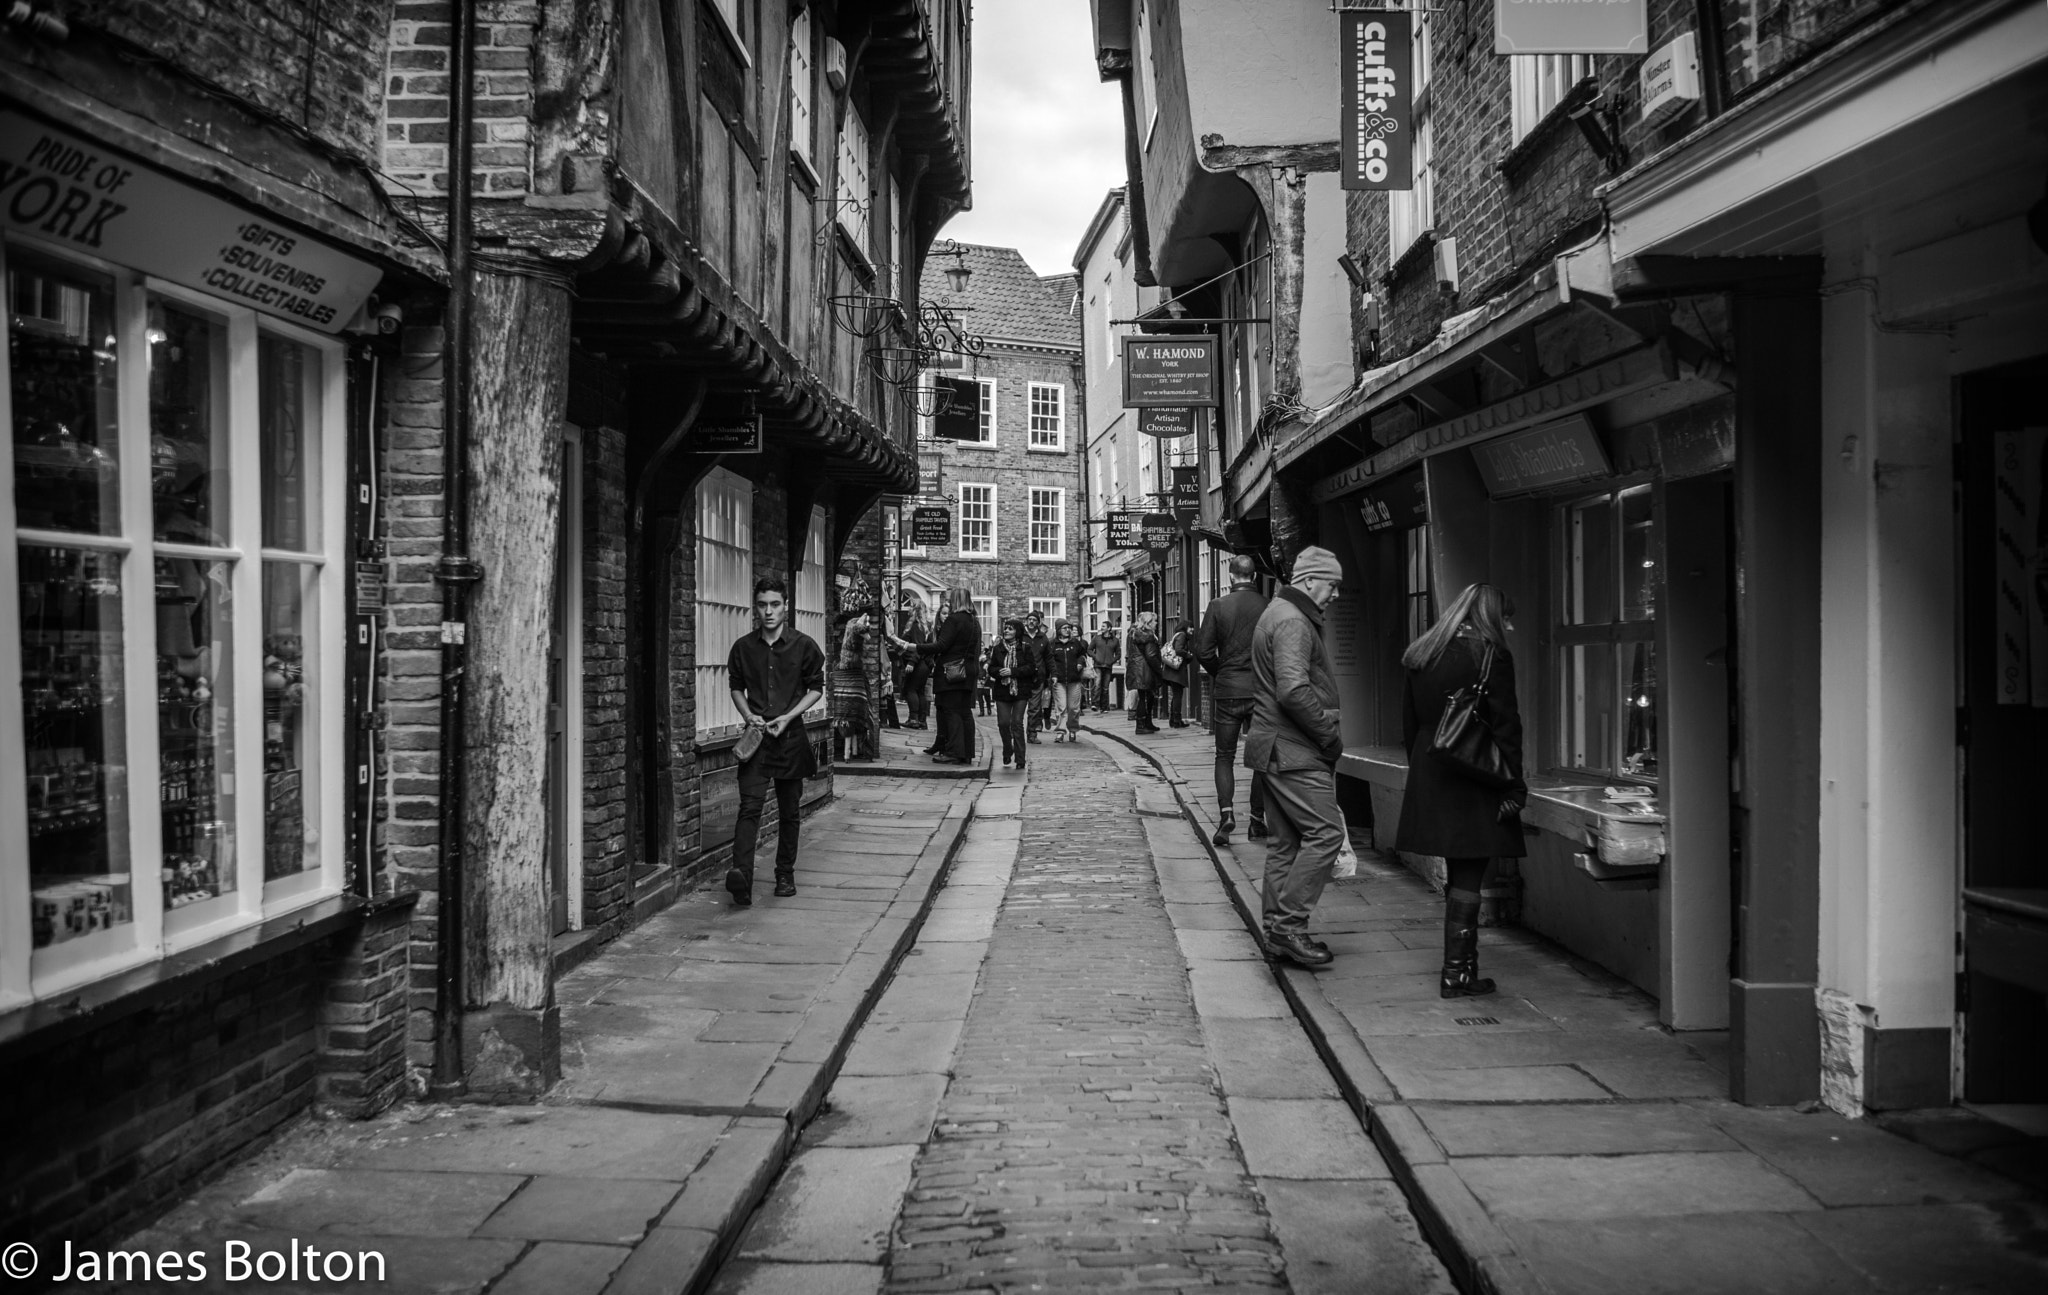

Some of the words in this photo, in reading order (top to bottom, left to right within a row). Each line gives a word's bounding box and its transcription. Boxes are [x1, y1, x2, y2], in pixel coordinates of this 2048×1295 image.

[1365, 21, 1398, 183] cuffs&co
[26, 136, 98, 182] PRIDE
[94, 165, 133, 194] OF
[241, 223, 297, 256] GIFTS
[223, 245, 327, 295] SOUVENIRS
[206, 268, 338, 325] COLLECTABLES
[1135, 347, 1150, 359] W.
[1153, 348, 1205, 359] HAMOND
[1146, 423, 1187, 432] Chocolates
[1154, 414, 1180, 422] Artisan
[1510, 433, 1585, 478] Shambles
[1180, 484, 1199, 493] VEC
[1191, 475, 1198, 483] V
[1131, 523, 1142, 532] BA
